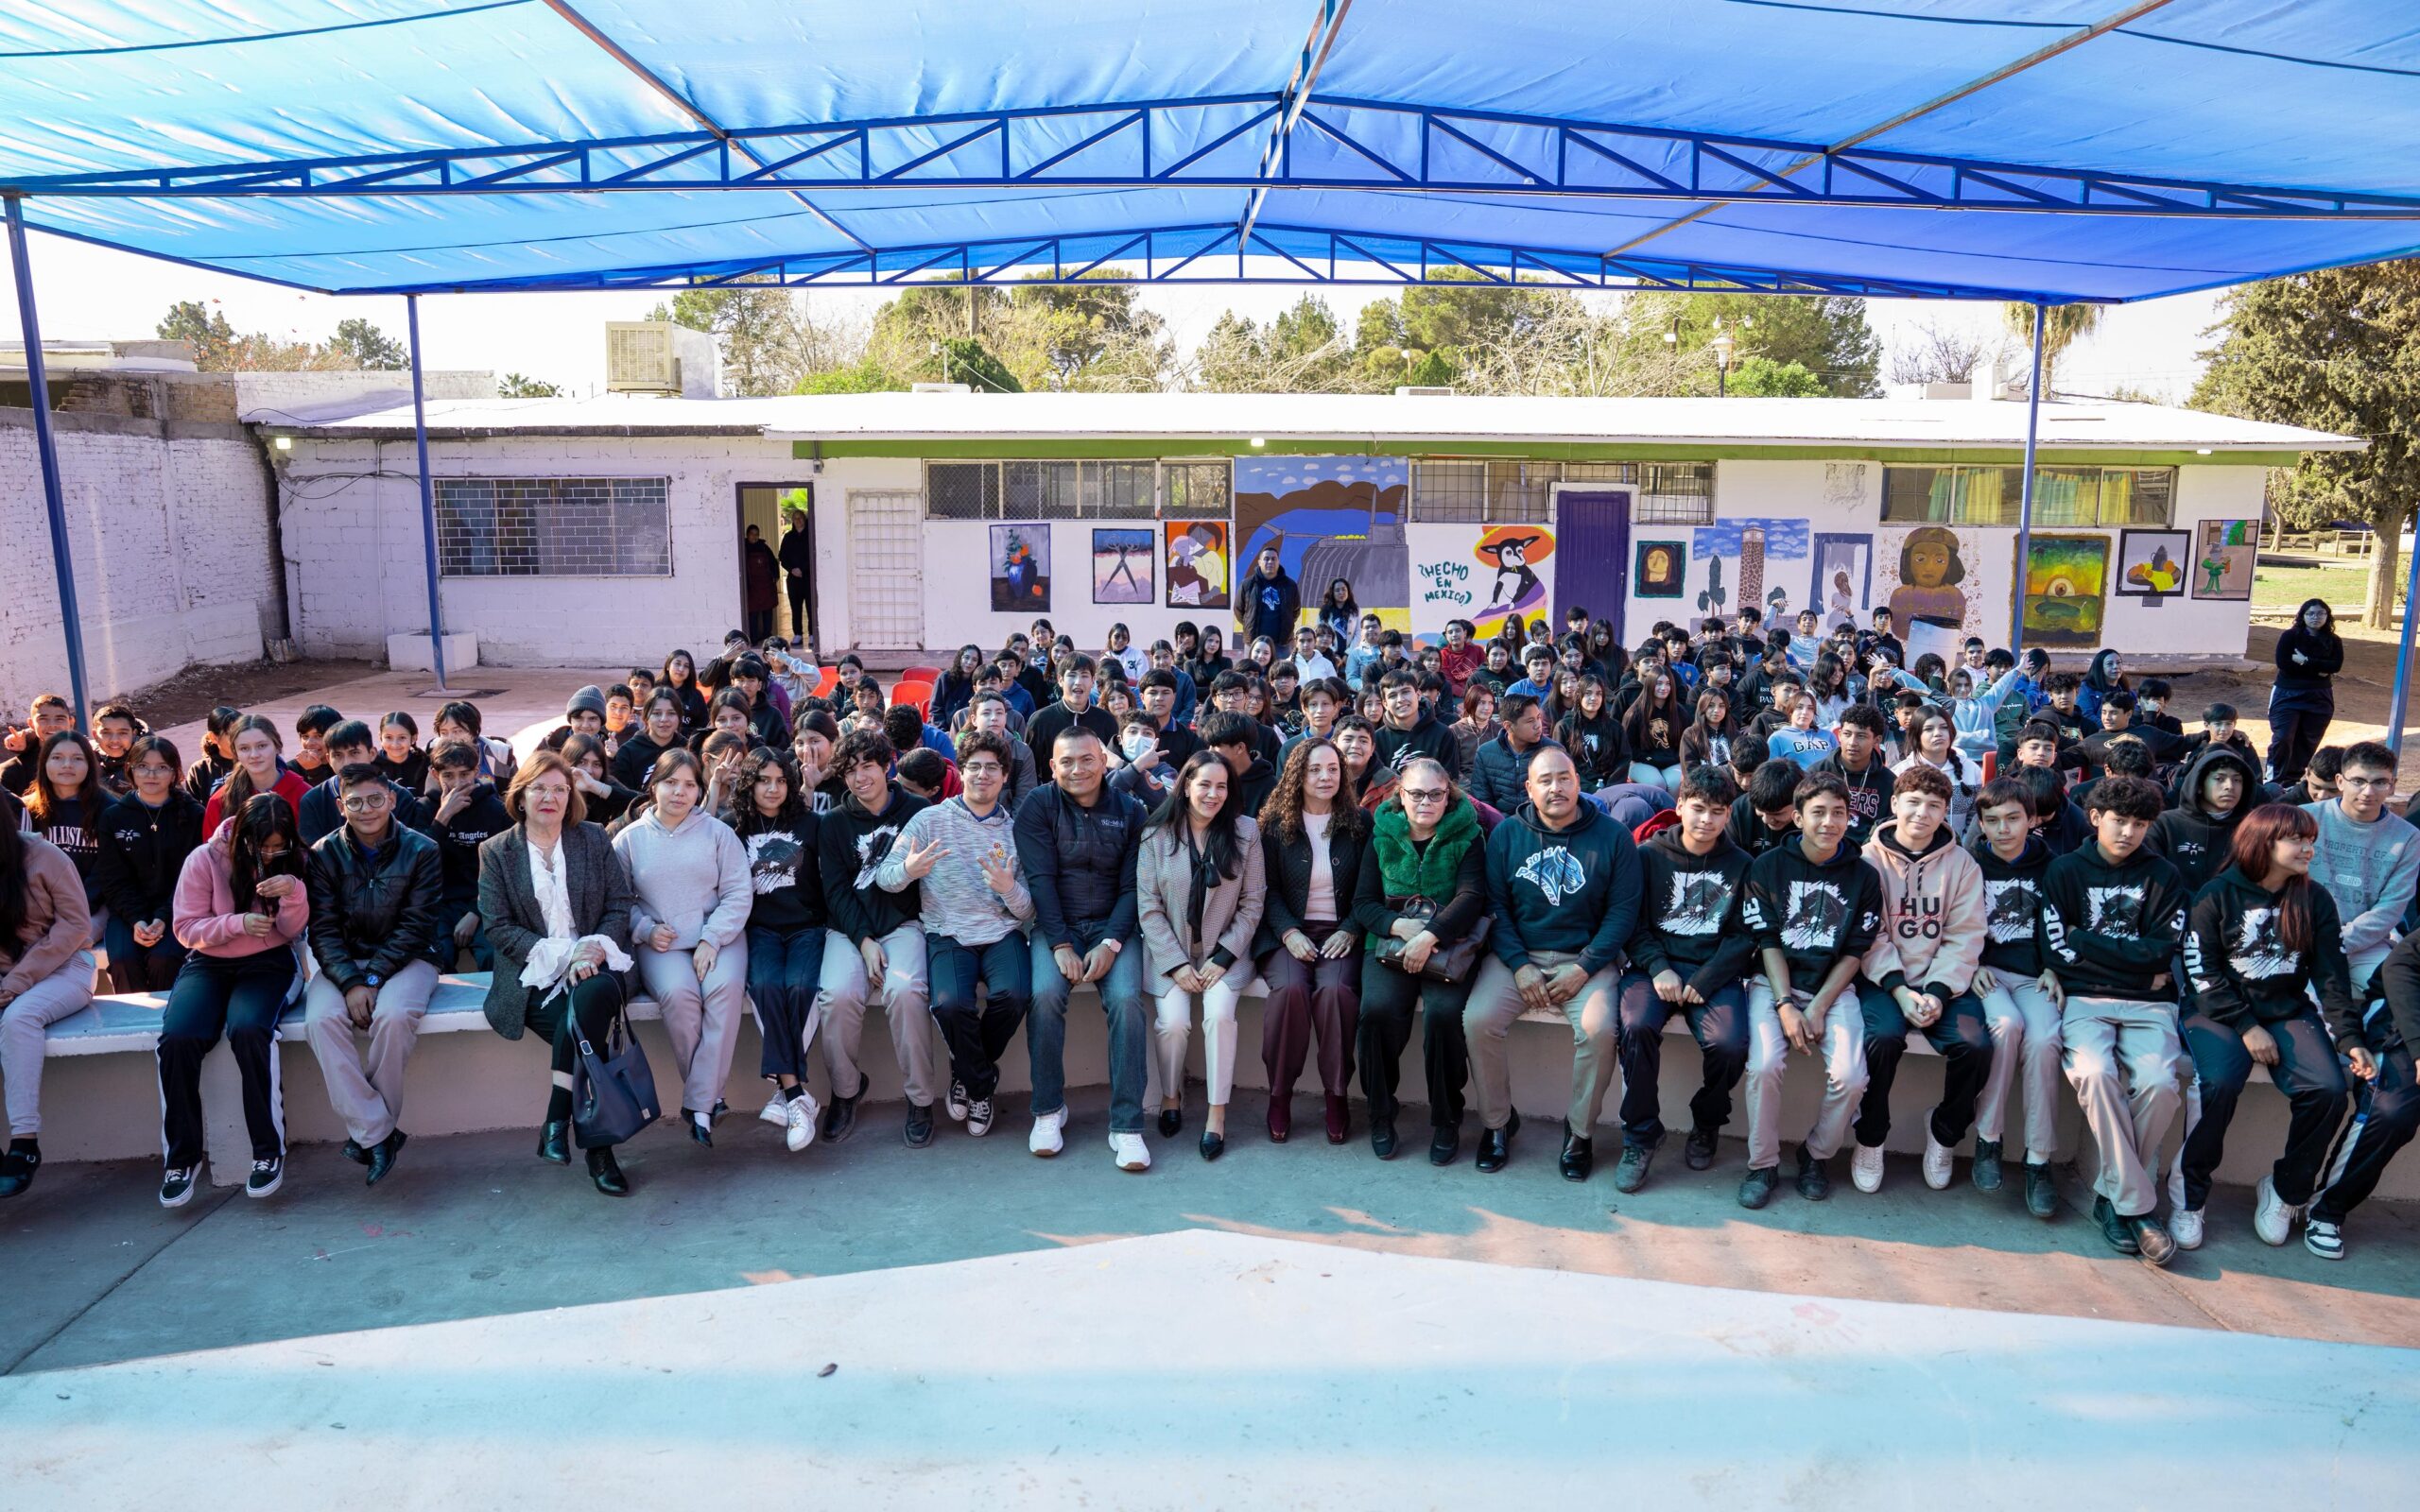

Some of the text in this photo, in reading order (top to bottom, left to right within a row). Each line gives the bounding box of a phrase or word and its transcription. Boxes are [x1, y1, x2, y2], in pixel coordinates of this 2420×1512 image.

[1436, 576, 1452, 588] EN
[1792, 740, 1829, 753] GAP
[2374, 850, 2388, 860] OF
[1900, 897, 1940, 917] HU
[1898, 919, 1941, 939] GO
